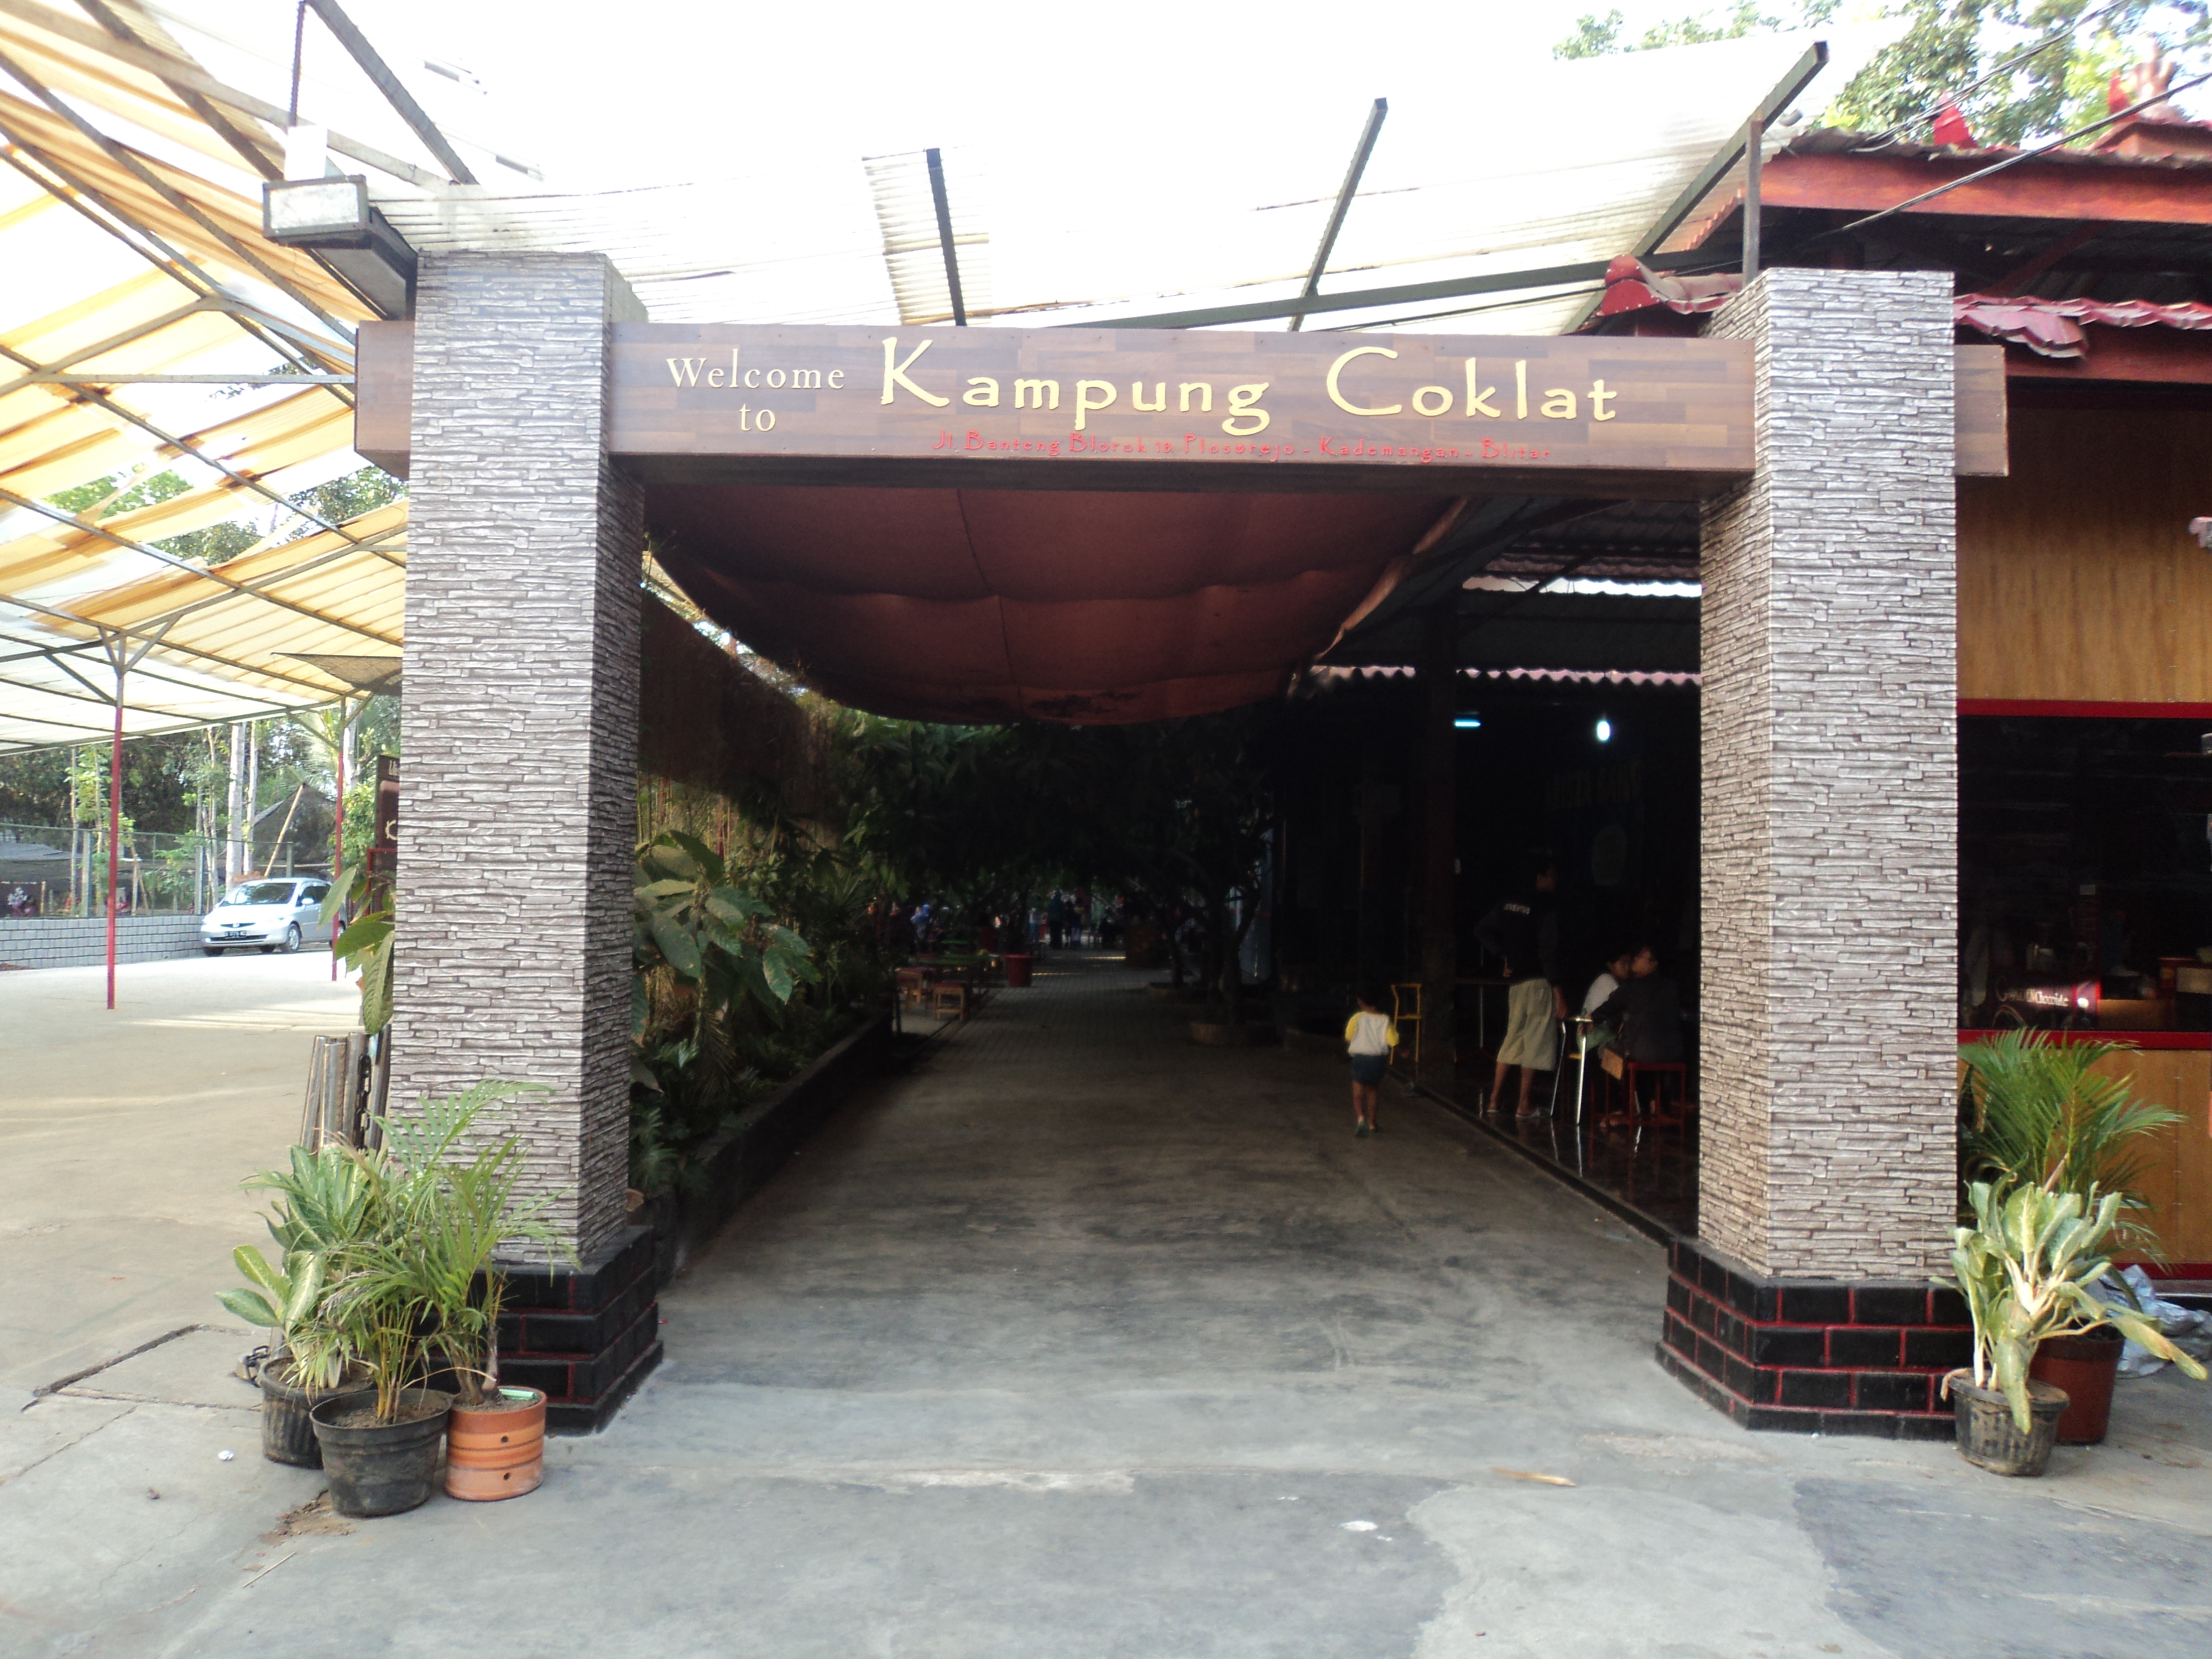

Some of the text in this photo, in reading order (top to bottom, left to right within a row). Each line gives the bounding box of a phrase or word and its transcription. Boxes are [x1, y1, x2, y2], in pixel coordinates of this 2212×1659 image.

[666, 348, 845, 389] Welcome
[880, 336, 1618, 436] Kampung Coklat
[739, 403, 776, 431] to
[964, 429, 1060, 456] Banteng
[1069, 431, 1147, 453] Blorok
[1183, 433, 1295, 462] Plosorejo
[1319, 435, 1459, 464] Kademangan
[1481, 437, 1551, 460] Blitar
